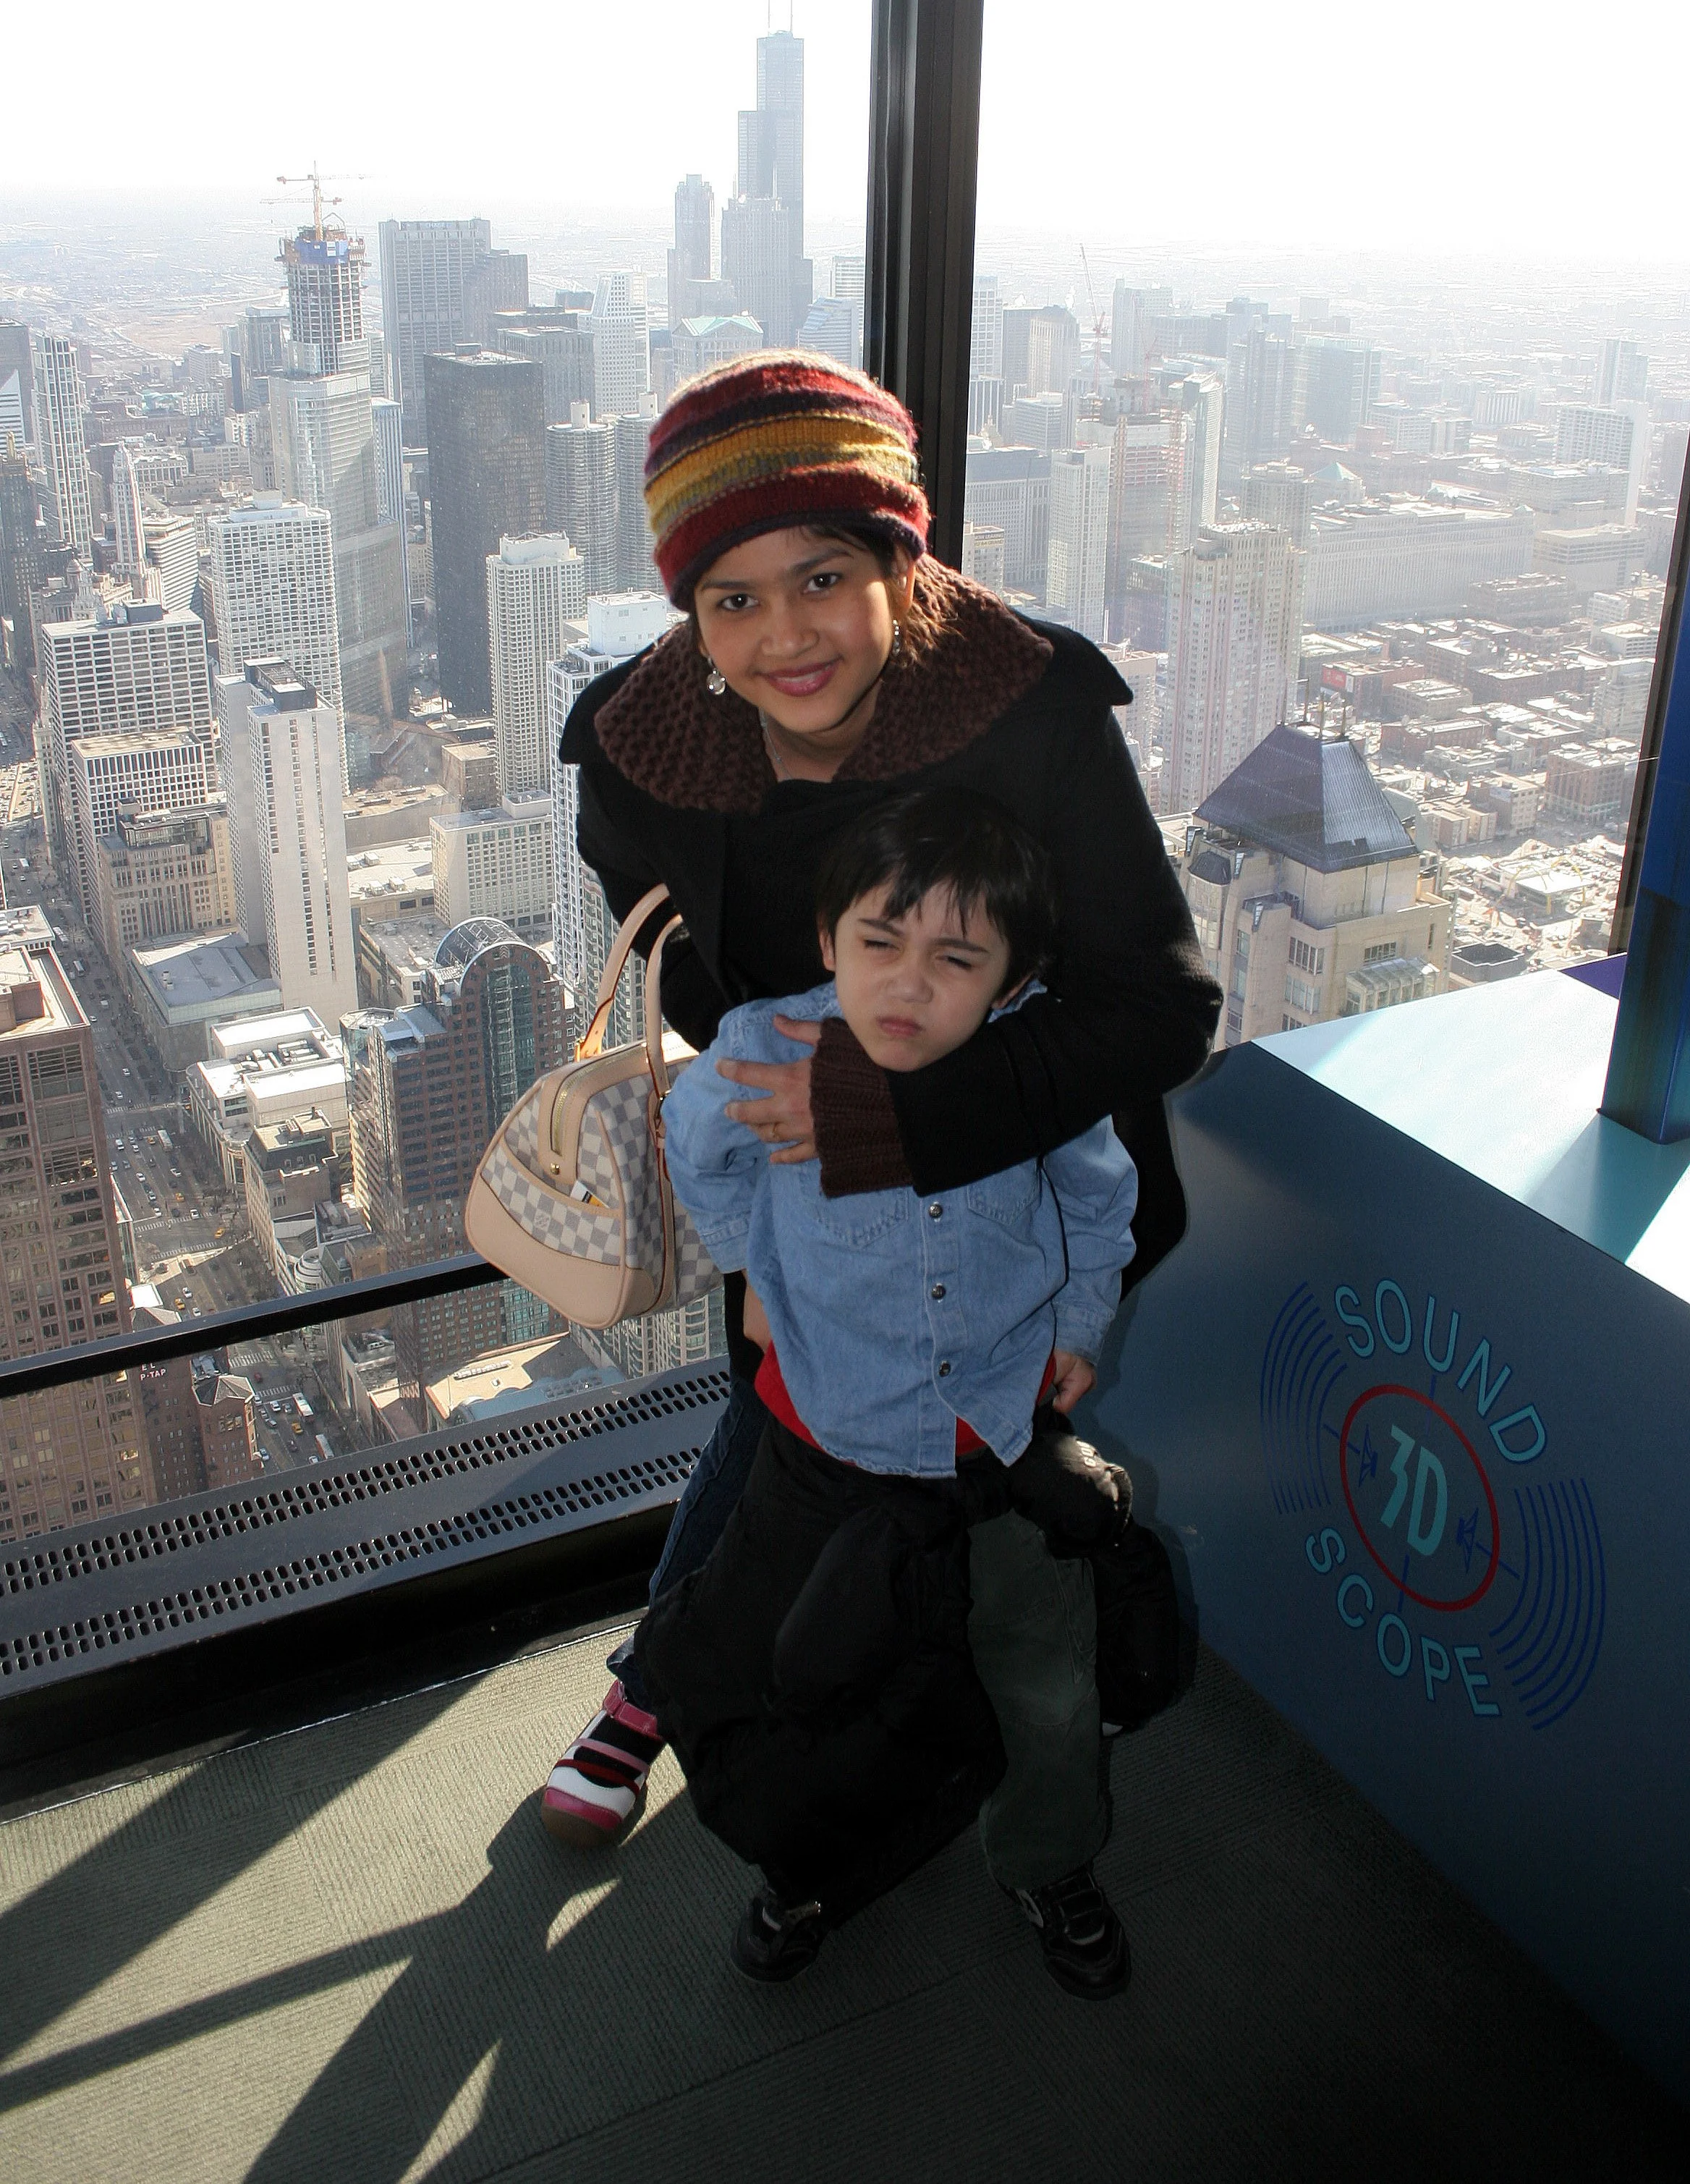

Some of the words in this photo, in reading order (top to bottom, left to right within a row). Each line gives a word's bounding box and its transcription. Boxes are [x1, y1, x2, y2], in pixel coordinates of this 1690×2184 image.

[1335, 1279, 1547, 1463] SOUND
[1380, 1425, 1448, 1557] 3D
[1306, 1528, 1500, 1717] SCOPE
